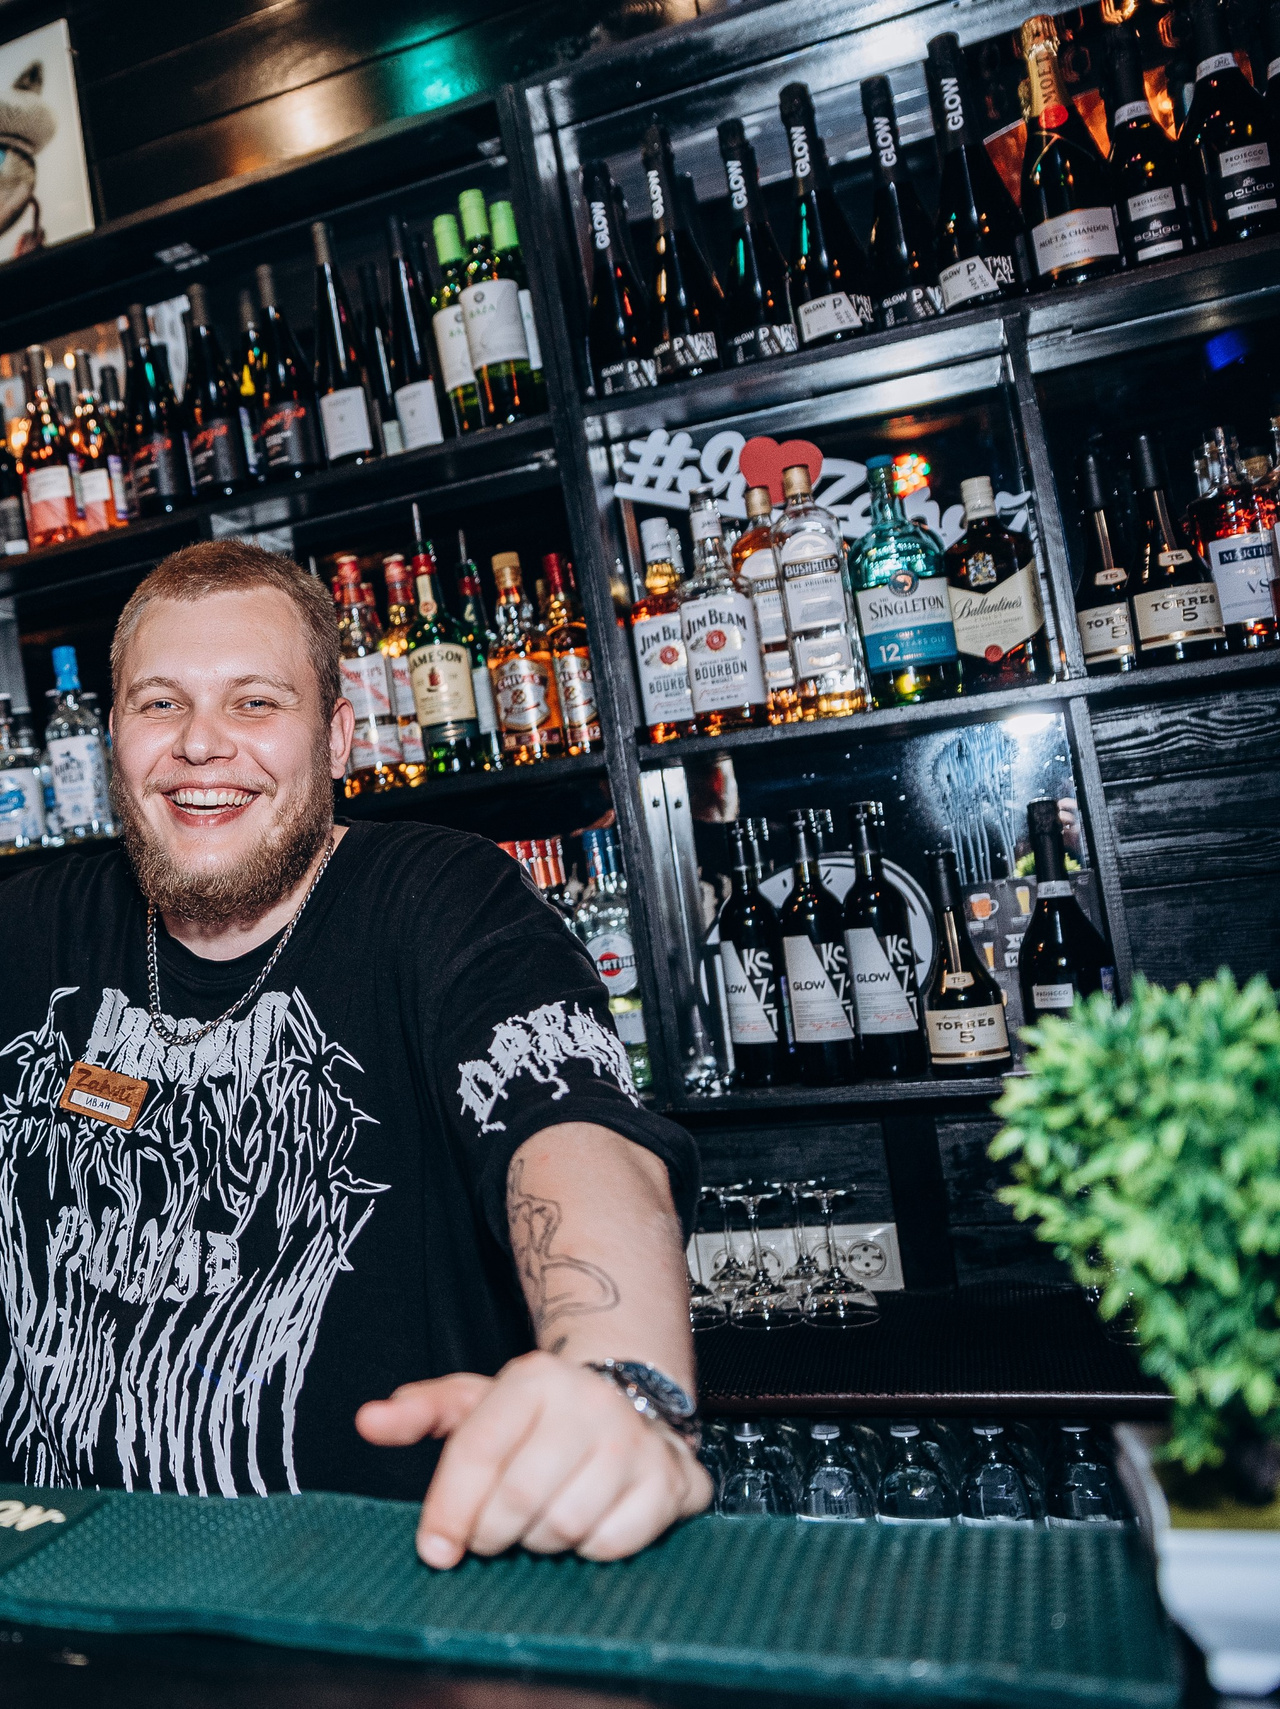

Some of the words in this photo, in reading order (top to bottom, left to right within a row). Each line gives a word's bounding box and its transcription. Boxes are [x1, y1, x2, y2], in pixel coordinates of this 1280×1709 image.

[940, 77, 965, 132] GLOW
[790, 125, 812, 179] GLOW
[873, 116, 898, 168] GLOW
[647, 169, 665, 220] GLOW
[726, 160, 749, 210] GLOW
[590, 201, 611, 250] GLOW
[785, 557, 839, 578] BUSHMILLS
[868, 594, 945, 621] SINGLETON
[1150, 594, 1216, 612] TORRES
[685, 614, 707, 641] JIM
[708, 608, 747, 631] BEAM
[1182, 606, 1199, 622] 5
[639, 630, 662, 656] JIM
[878, 642, 902, 664] 12
[694, 660, 748, 681] BOURBON
[792, 979, 826, 992] GLOW
[856, 971, 891, 984] GLOW
[726, 983, 747, 994] LOW
[935, 1016, 996, 1031] TORRES
[959, 1030, 976, 1044] 5
[85, 1096, 111, 1110] ИВАН
